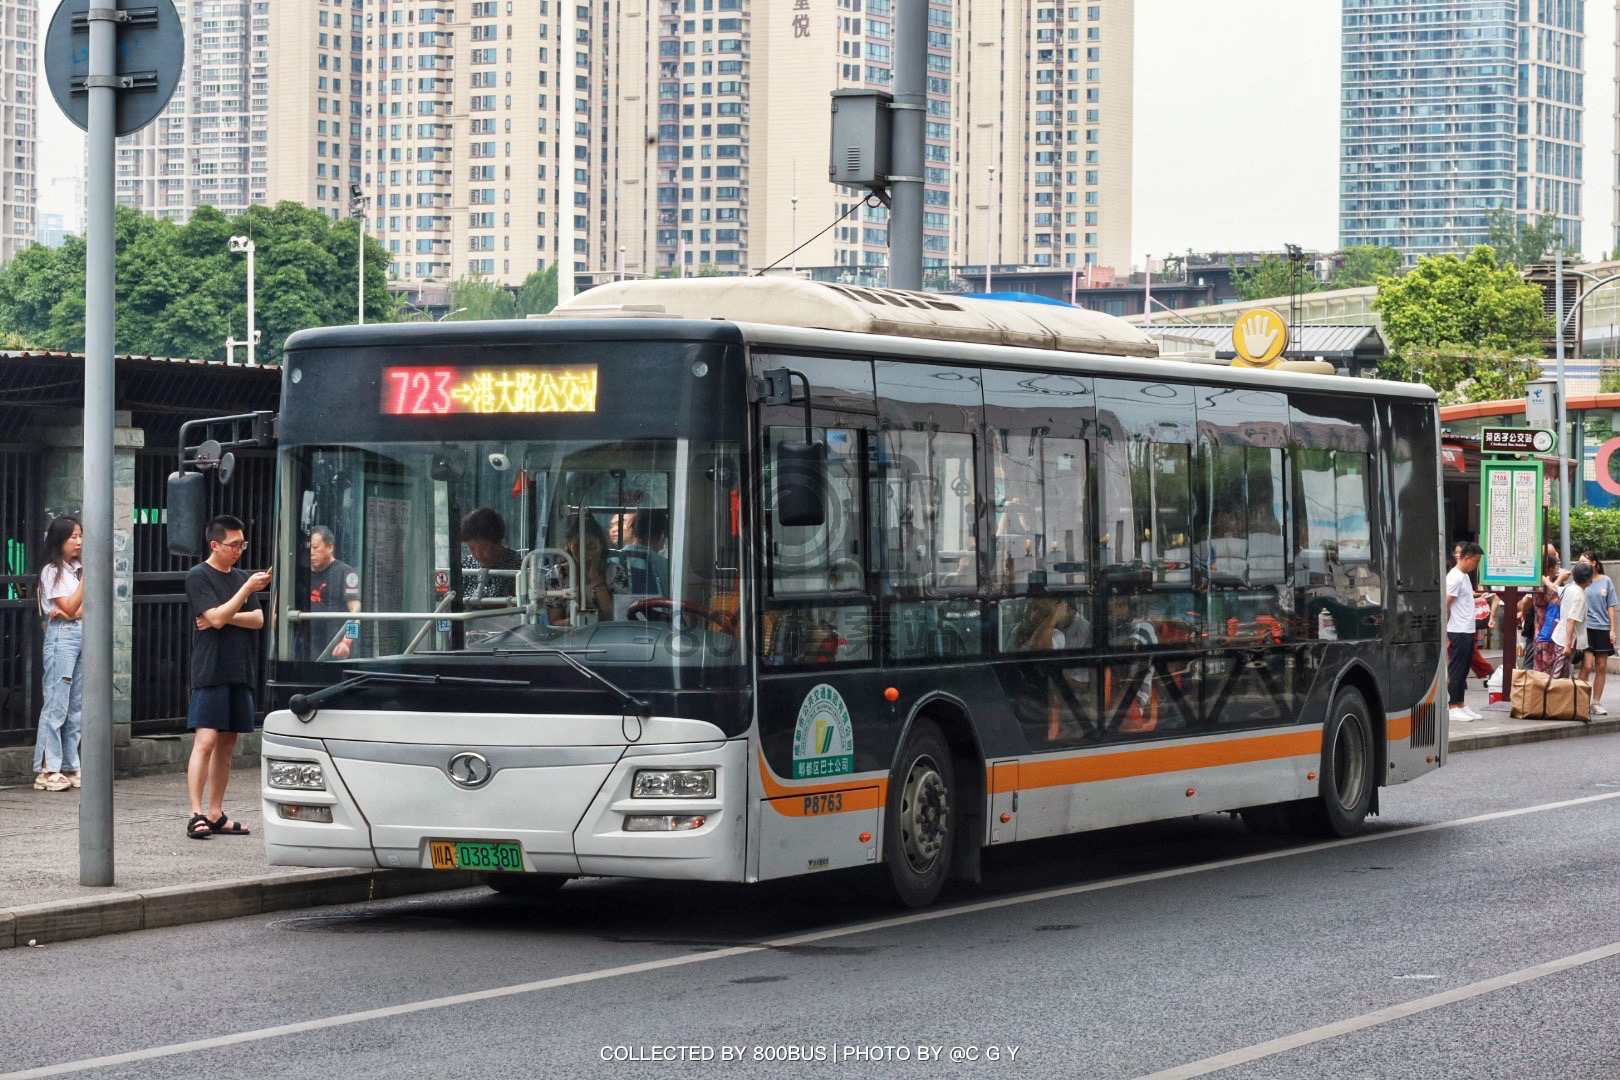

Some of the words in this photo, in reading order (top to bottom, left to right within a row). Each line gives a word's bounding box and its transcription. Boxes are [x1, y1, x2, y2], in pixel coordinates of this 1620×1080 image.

[391, 371, 451, 414] 723
[1485, 432, 1533, 443] 茶店子公交站
[803, 793, 843, 815] P8763
